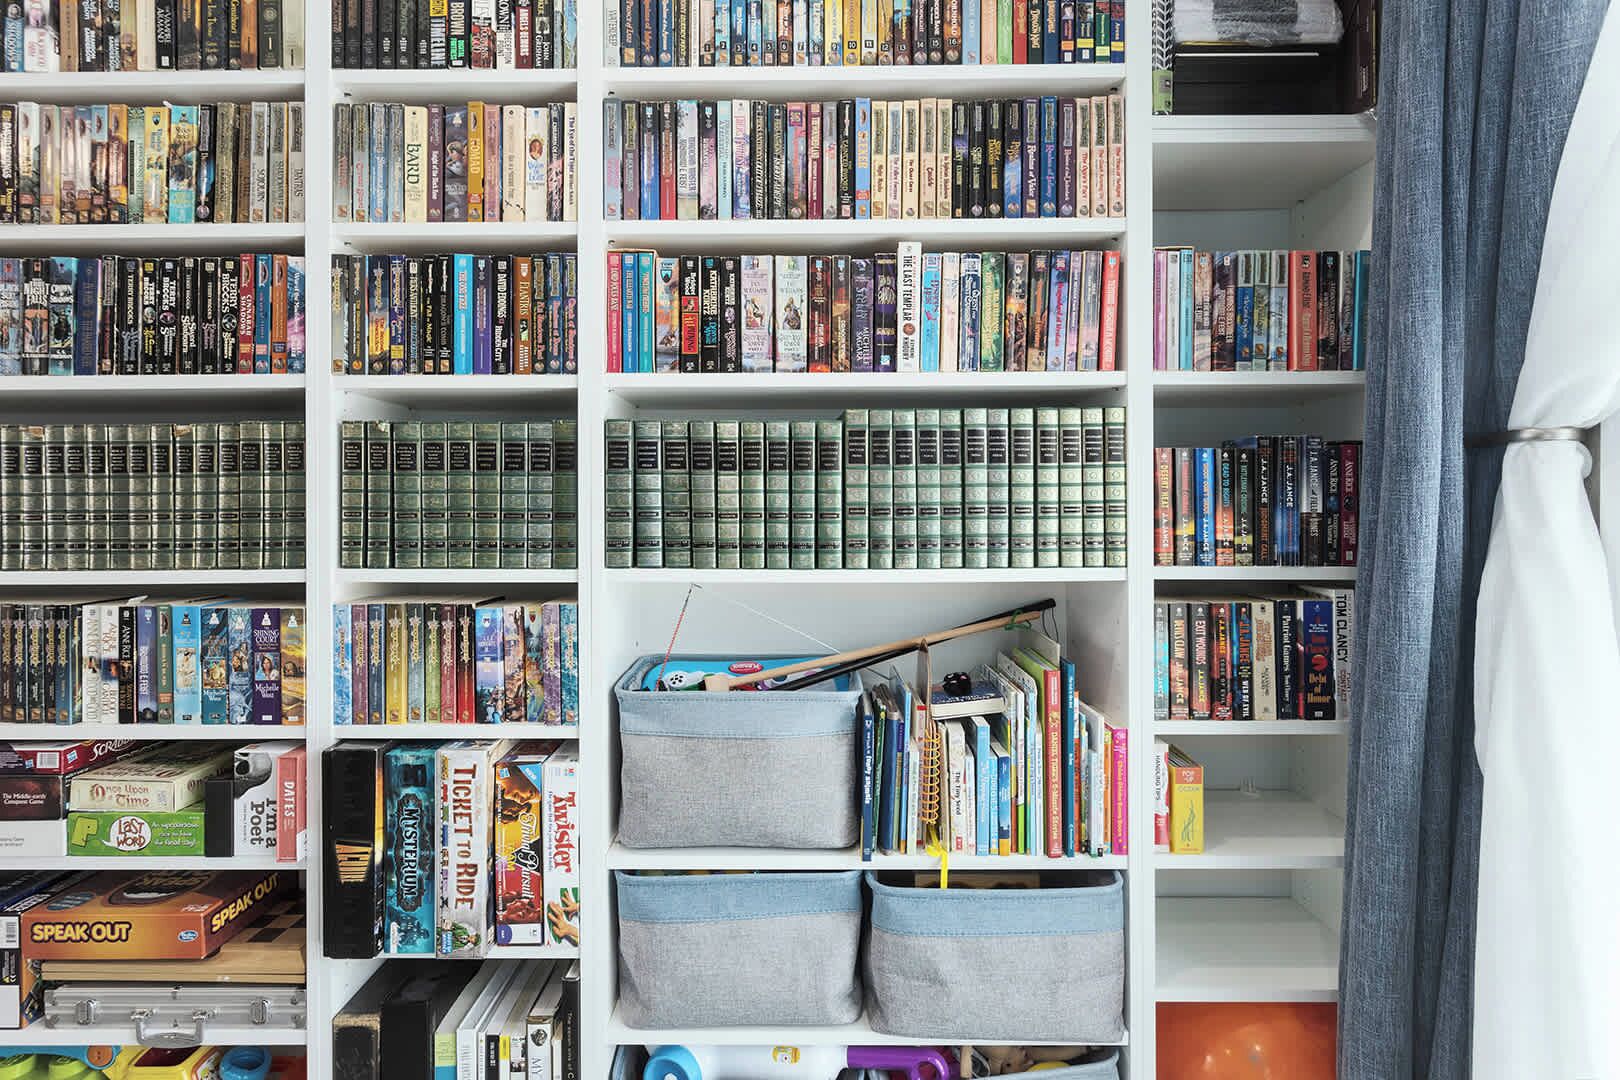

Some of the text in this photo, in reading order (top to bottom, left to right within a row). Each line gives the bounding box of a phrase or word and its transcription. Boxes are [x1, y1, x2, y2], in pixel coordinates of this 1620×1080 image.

[450, 2, 464, 35] BROWN
[520, 9, 528, 29] ANGELS
[608, 10, 616, 46] WATERDEEP
[8, 23, 16, 61] SHADOWS
[431, 17, 445, 66] TIMELINE
[407, 144, 421, 184] BARD
[470, 138, 480, 174] NOMAD
[858, 130, 868, 168] SEEKER
[1027, 145, 1036, 170] Realms
[257, 169, 266, 202] SOJOURN
[294, 168, 303, 197] TANTRAS
[230, 276, 238, 308] TERRY
[498, 274, 506, 318] DAVID EDDINGS
[520, 282, 528, 315] ELANTRIS
[903, 256, 912, 321] THE LAST TEMPLAR
[972, 289, 980, 311] QUEST
[1160, 465, 1168, 508] DESERT HEAT
[1310, 465, 1318, 487] JANCE
[1329, 459, 1338, 493] ANNE RICE
[1260, 507, 1270, 560] JUDGMENT CALL
[1310, 518, 1319, 536] BONES
[102, 632, 111, 654] RICE
[122, 625, 131, 658] ANNE RICE
[1174, 619, 1184, 658] DEVIL'S CLAW
[1196, 621, 1206, 665] EXIT WOUNDS
[1283, 615, 1291, 642] Patriot
[1336, 594, 1347, 662] TOM CLANCY
[1240, 638, 1250, 663] JANCE
[140, 680, 148, 695] FEIST
[1175, 678, 1184, 704] JANCE
[1308, 693, 1330, 703] Honor
[90, 784, 149, 800] Once Upon
[116, 794, 149, 807] Time
[284, 782, 294, 817] DATES
[250, 802, 264, 845] Poet
[266, 798, 276, 848] I'm a
[453, 763, 477, 910] TICKET TO RIDE
[553, 792, 576, 872] Twister
[116, 834, 145, 848] WORD
[403, 808, 419, 897] MYSTERIUM
[519, 812, 539, 898] Trivial Pursuit
[210, 872, 279, 931] SPEAK OUT
[31, 922, 131, 942] SPEAK OUT
[532, 1057, 542, 1076] MY
